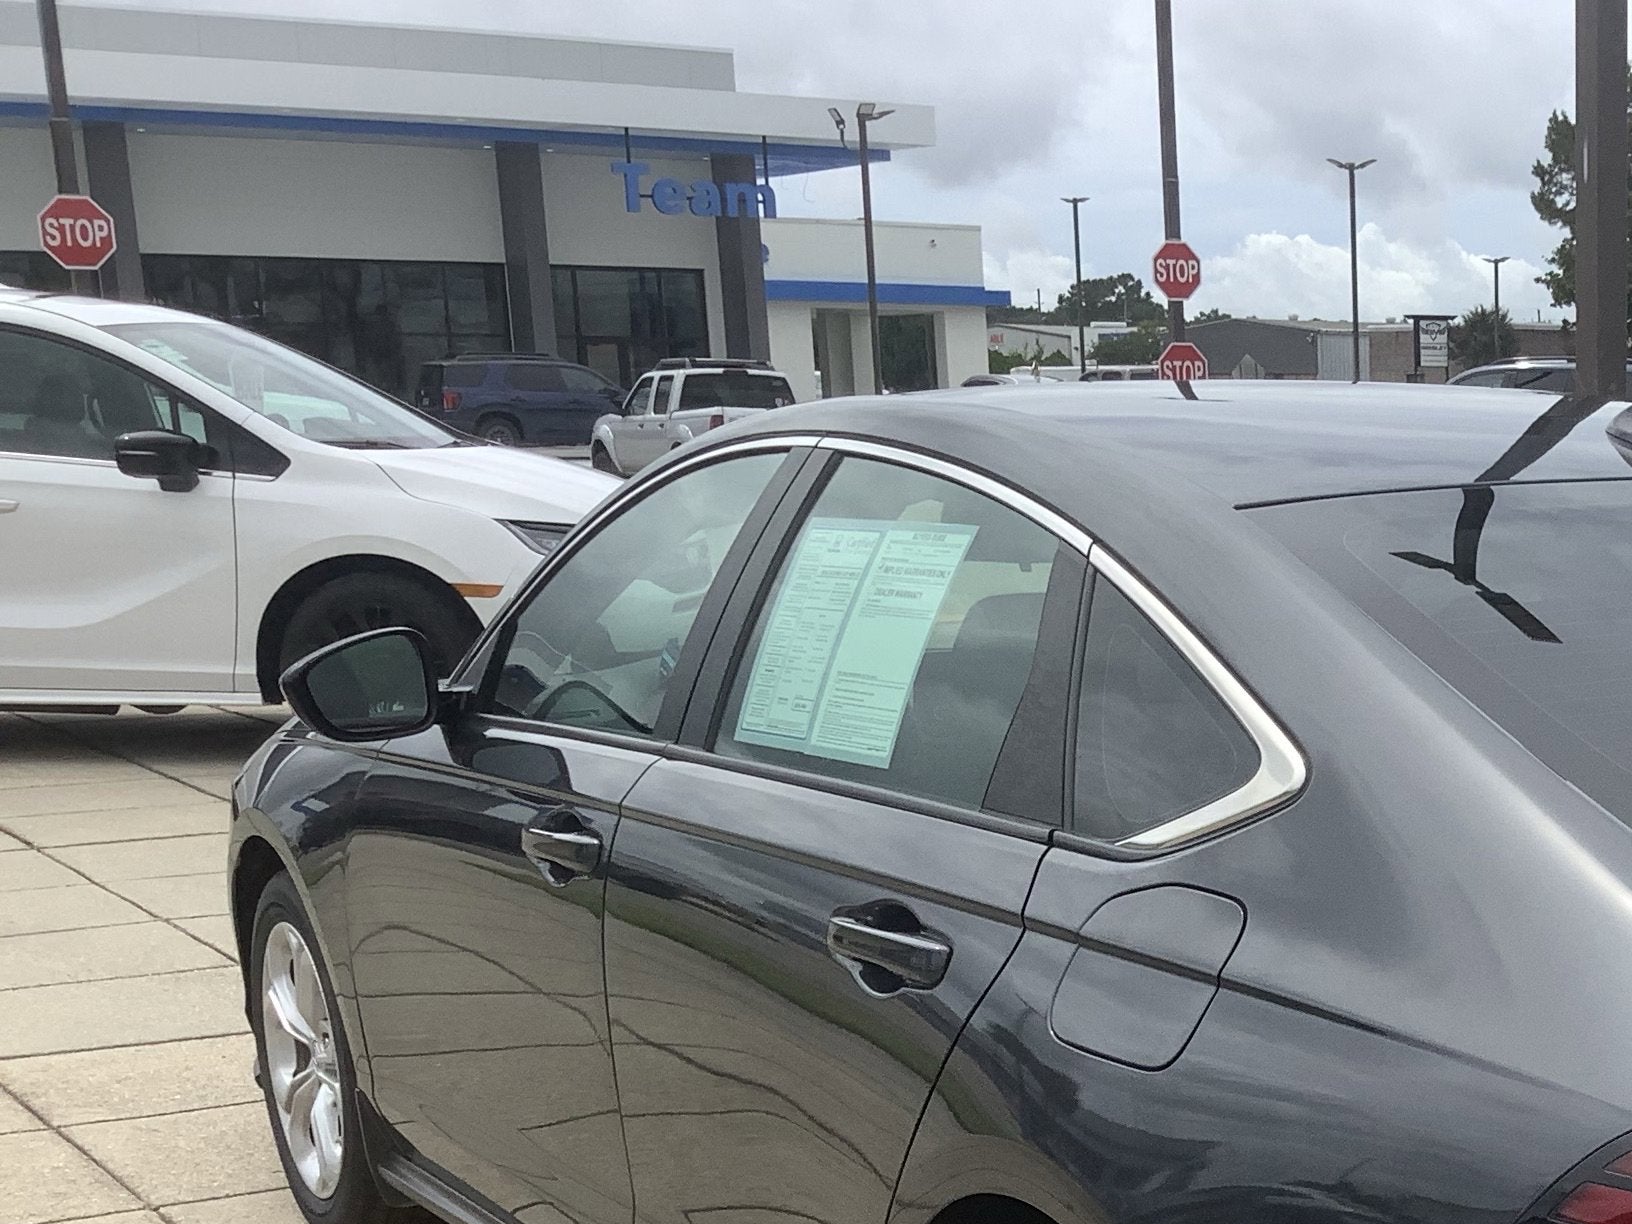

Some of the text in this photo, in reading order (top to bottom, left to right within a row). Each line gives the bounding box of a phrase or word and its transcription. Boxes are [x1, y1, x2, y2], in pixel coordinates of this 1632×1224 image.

[611, 160, 777, 219] Team
[43, 217, 109, 248] STOP
[1156, 258, 1199, 284] STOP
[1163, 360, 1204, 380] STOP
